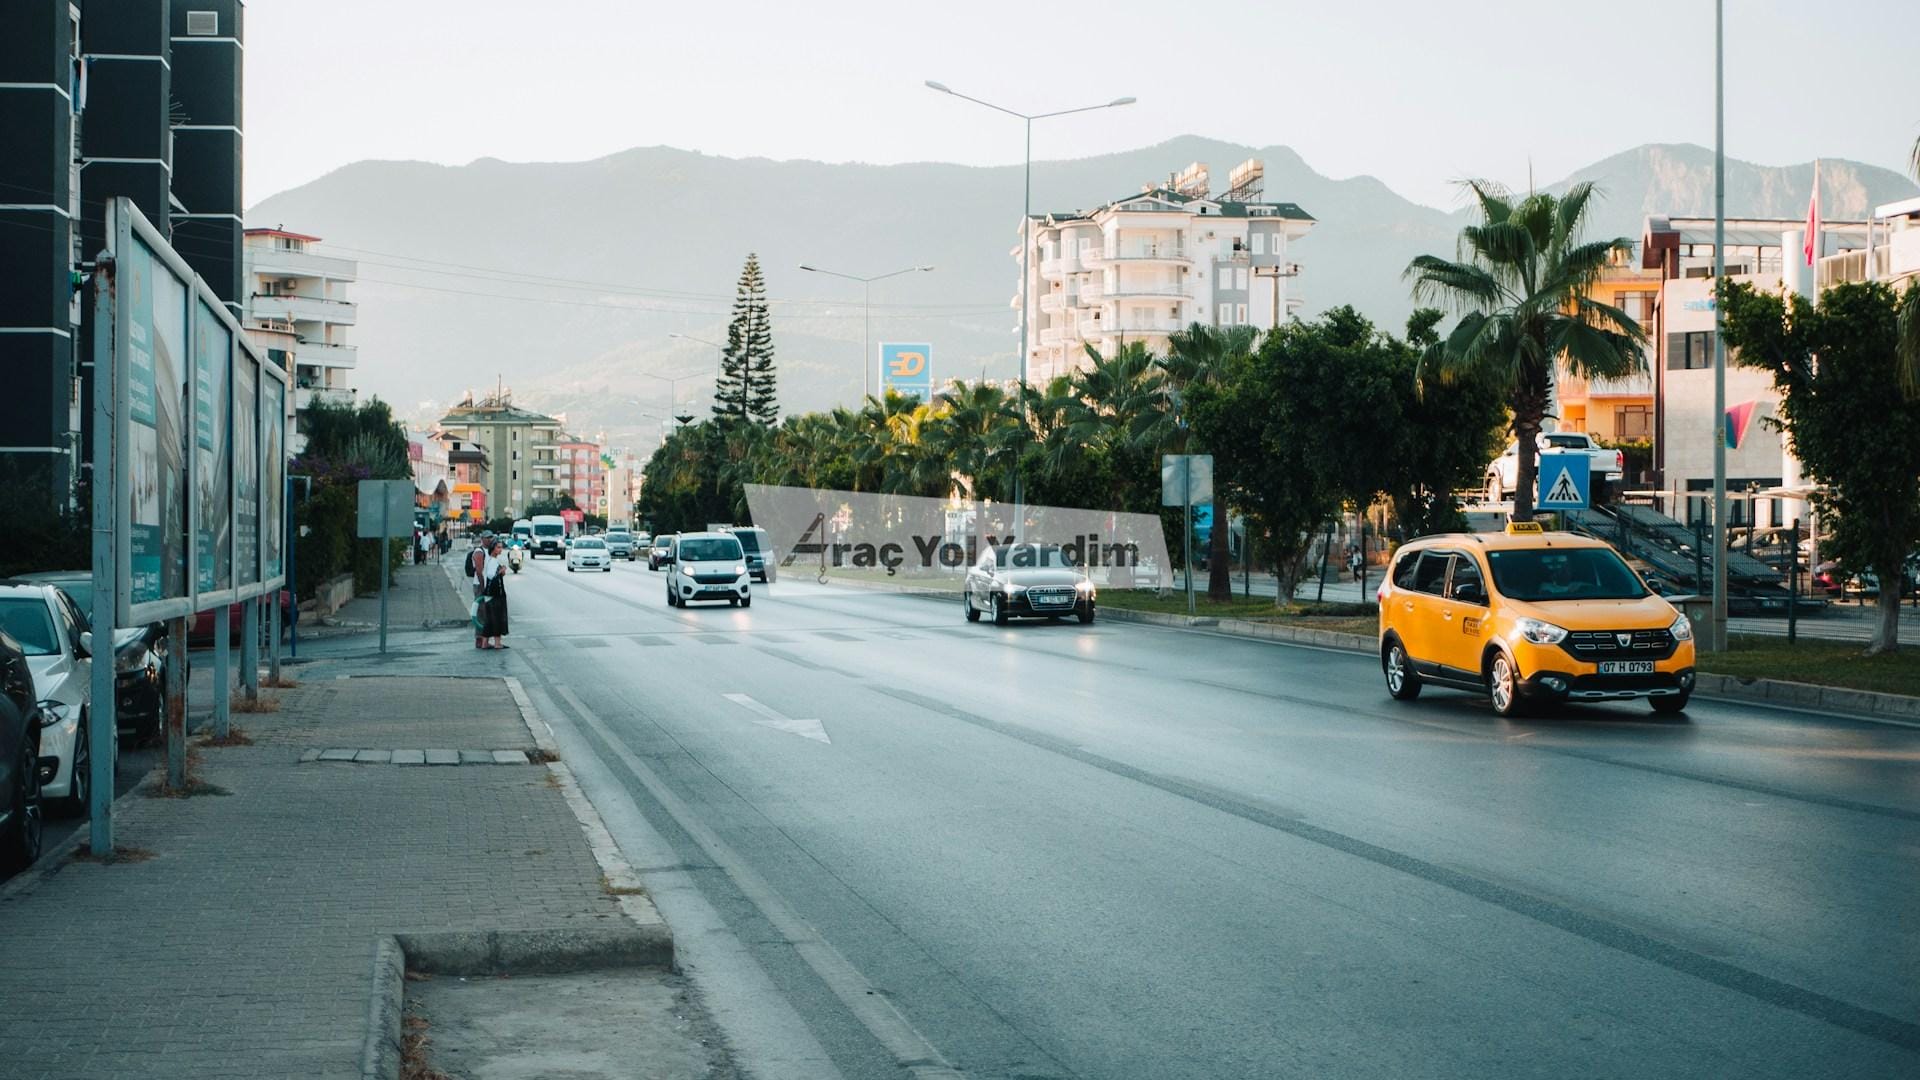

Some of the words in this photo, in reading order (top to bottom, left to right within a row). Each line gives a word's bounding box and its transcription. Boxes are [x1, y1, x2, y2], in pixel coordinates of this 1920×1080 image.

[1603, 662, 1615, 672] 07
[1619, 662, 1625, 672] H
[1629, 662, 1652, 672] 0793
